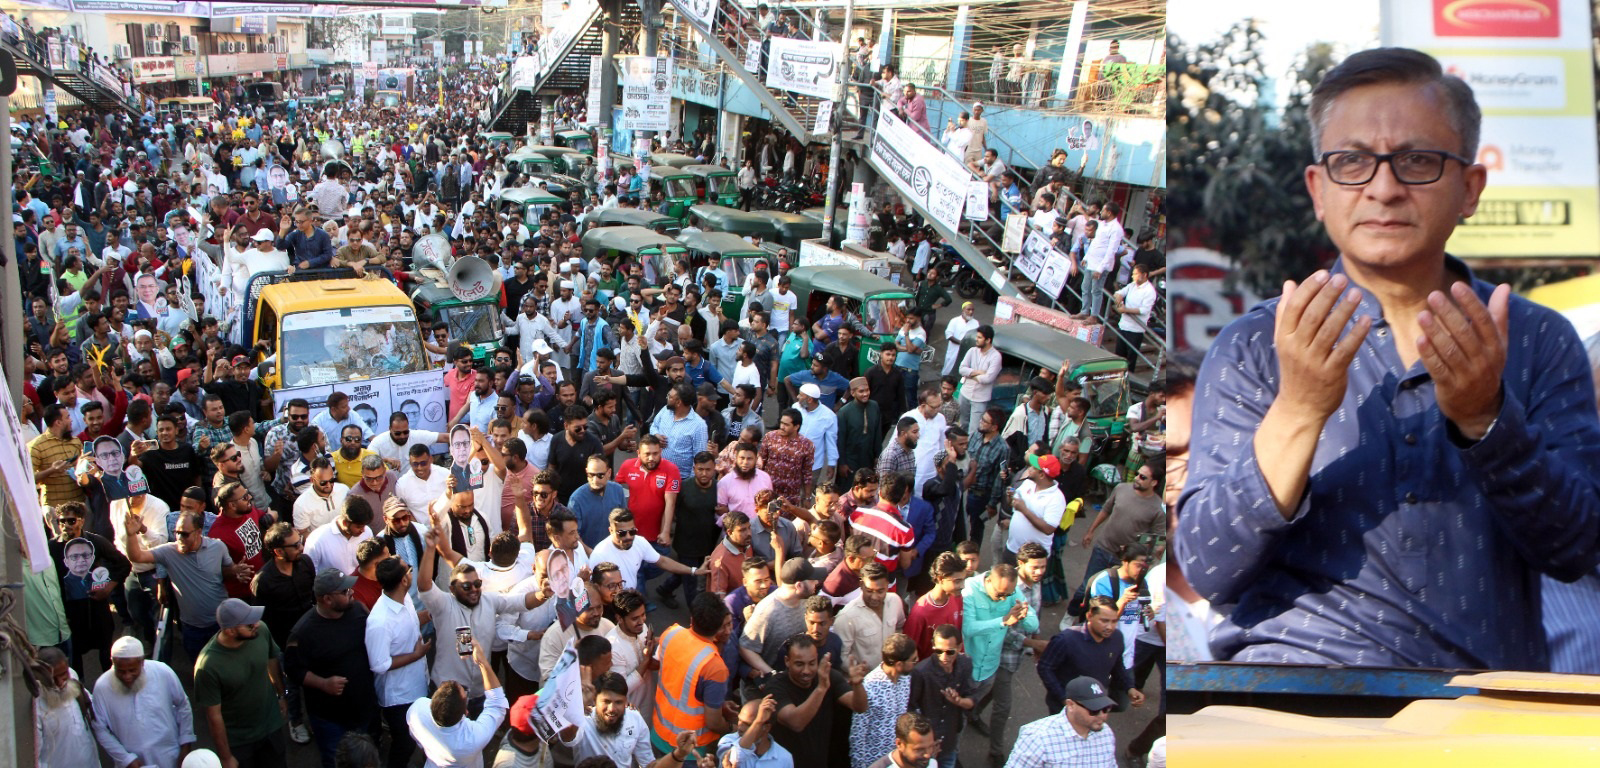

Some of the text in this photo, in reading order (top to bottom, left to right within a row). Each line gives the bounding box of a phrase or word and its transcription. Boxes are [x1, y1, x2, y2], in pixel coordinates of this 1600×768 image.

[1470, 72, 1558, 86] MoneyGram
[1510, 144, 1555, 159] Money
[1510, 159, 1563, 171] Transfer
[353, 384, 372, 393] সবার
[671, 479, 680, 490] 3
